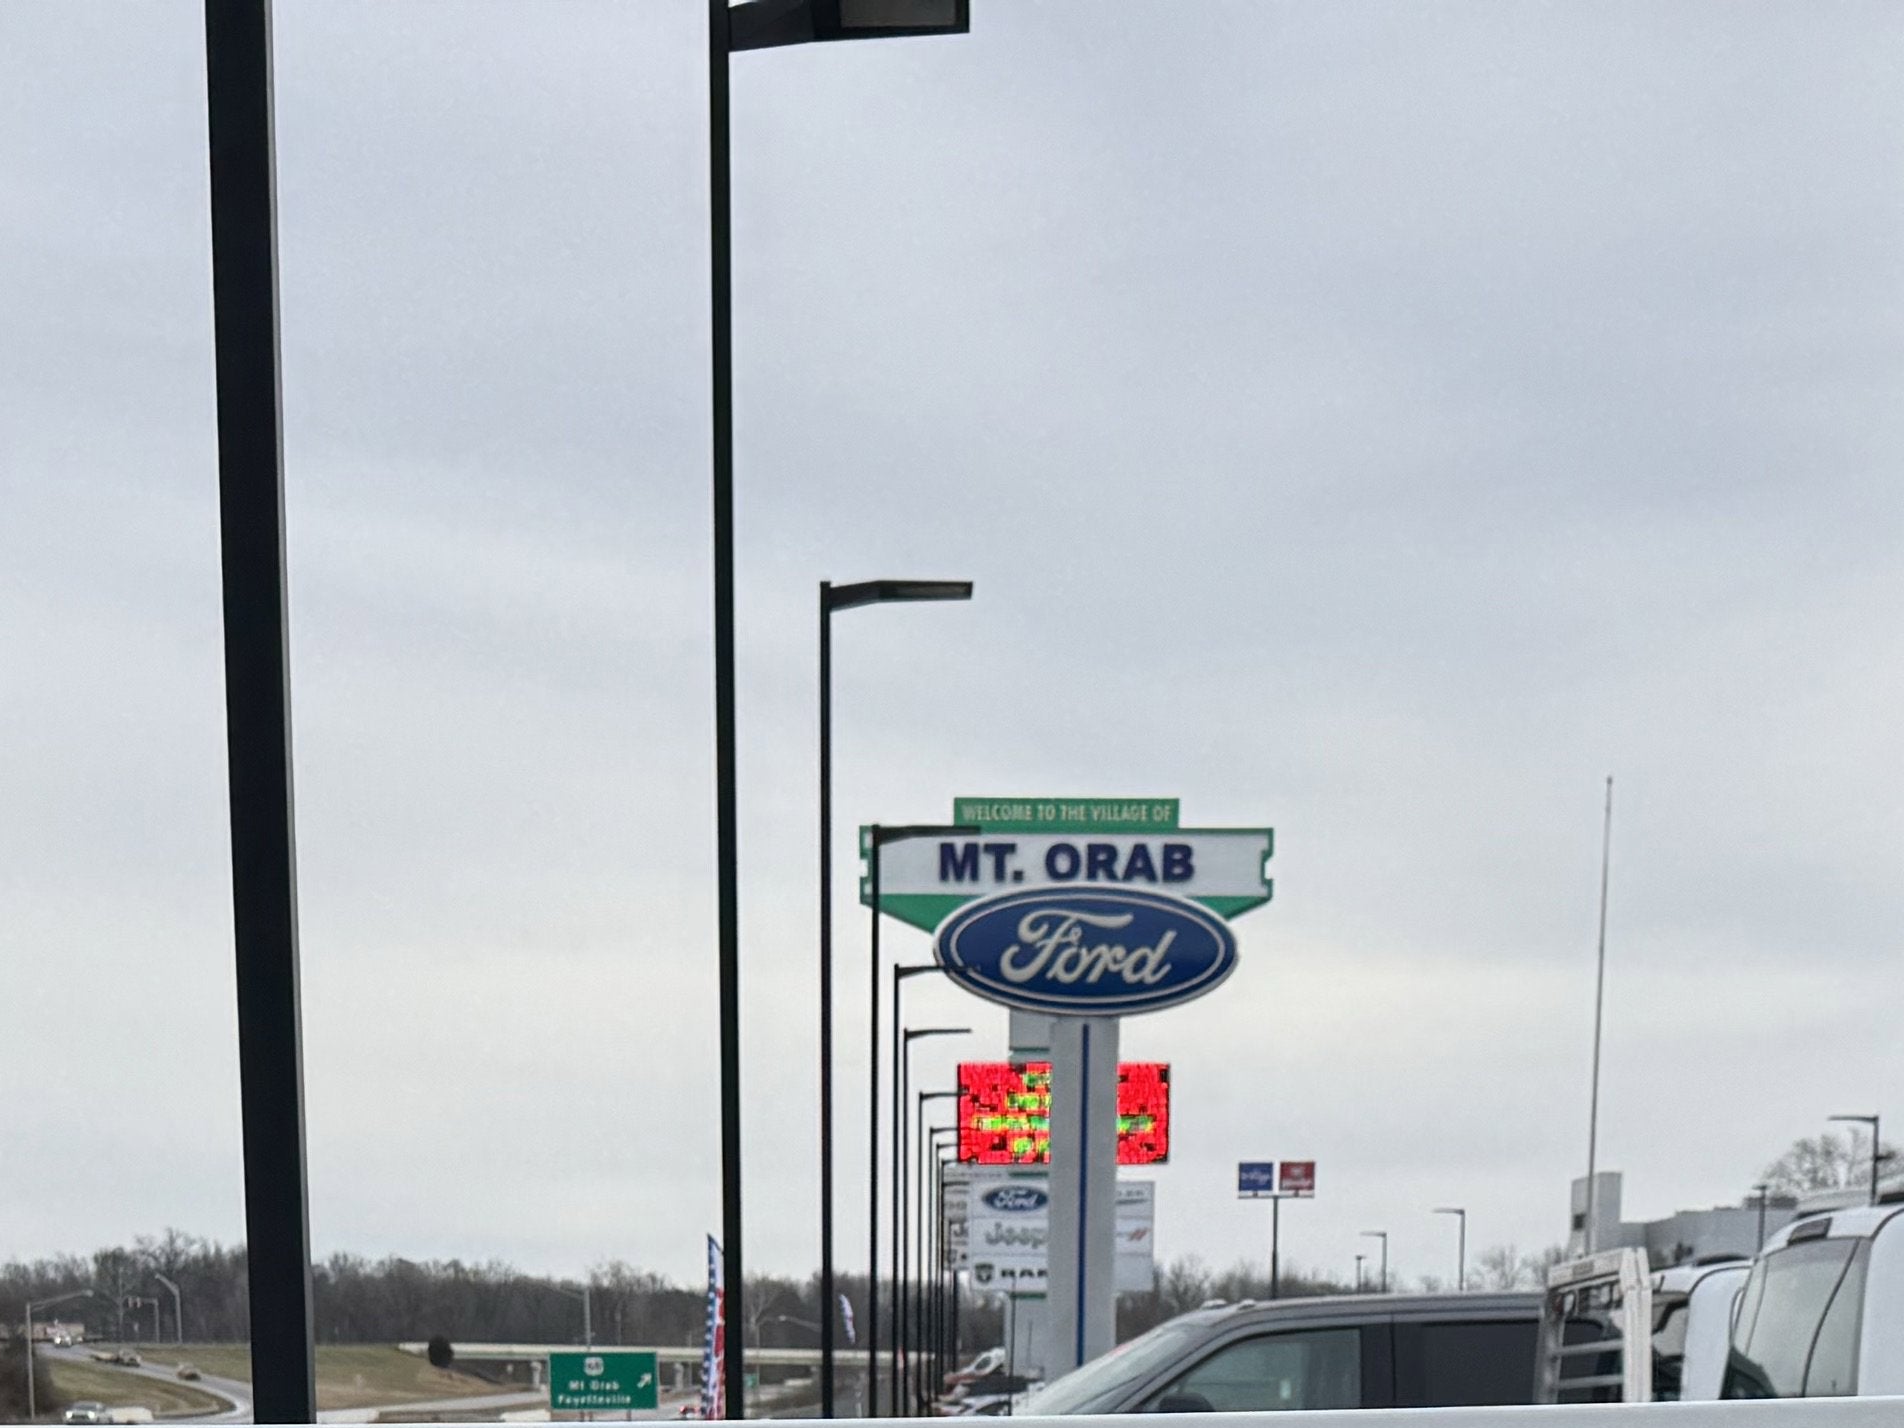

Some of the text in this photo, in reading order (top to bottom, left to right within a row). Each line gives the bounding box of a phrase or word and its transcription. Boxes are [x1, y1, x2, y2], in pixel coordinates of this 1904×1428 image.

[961, 804, 1173, 822] WELCOME TO THE VILLAGE OF
[938, 842, 1195, 883] MT. ORAB
[999, 909, 1178, 984] Ford
